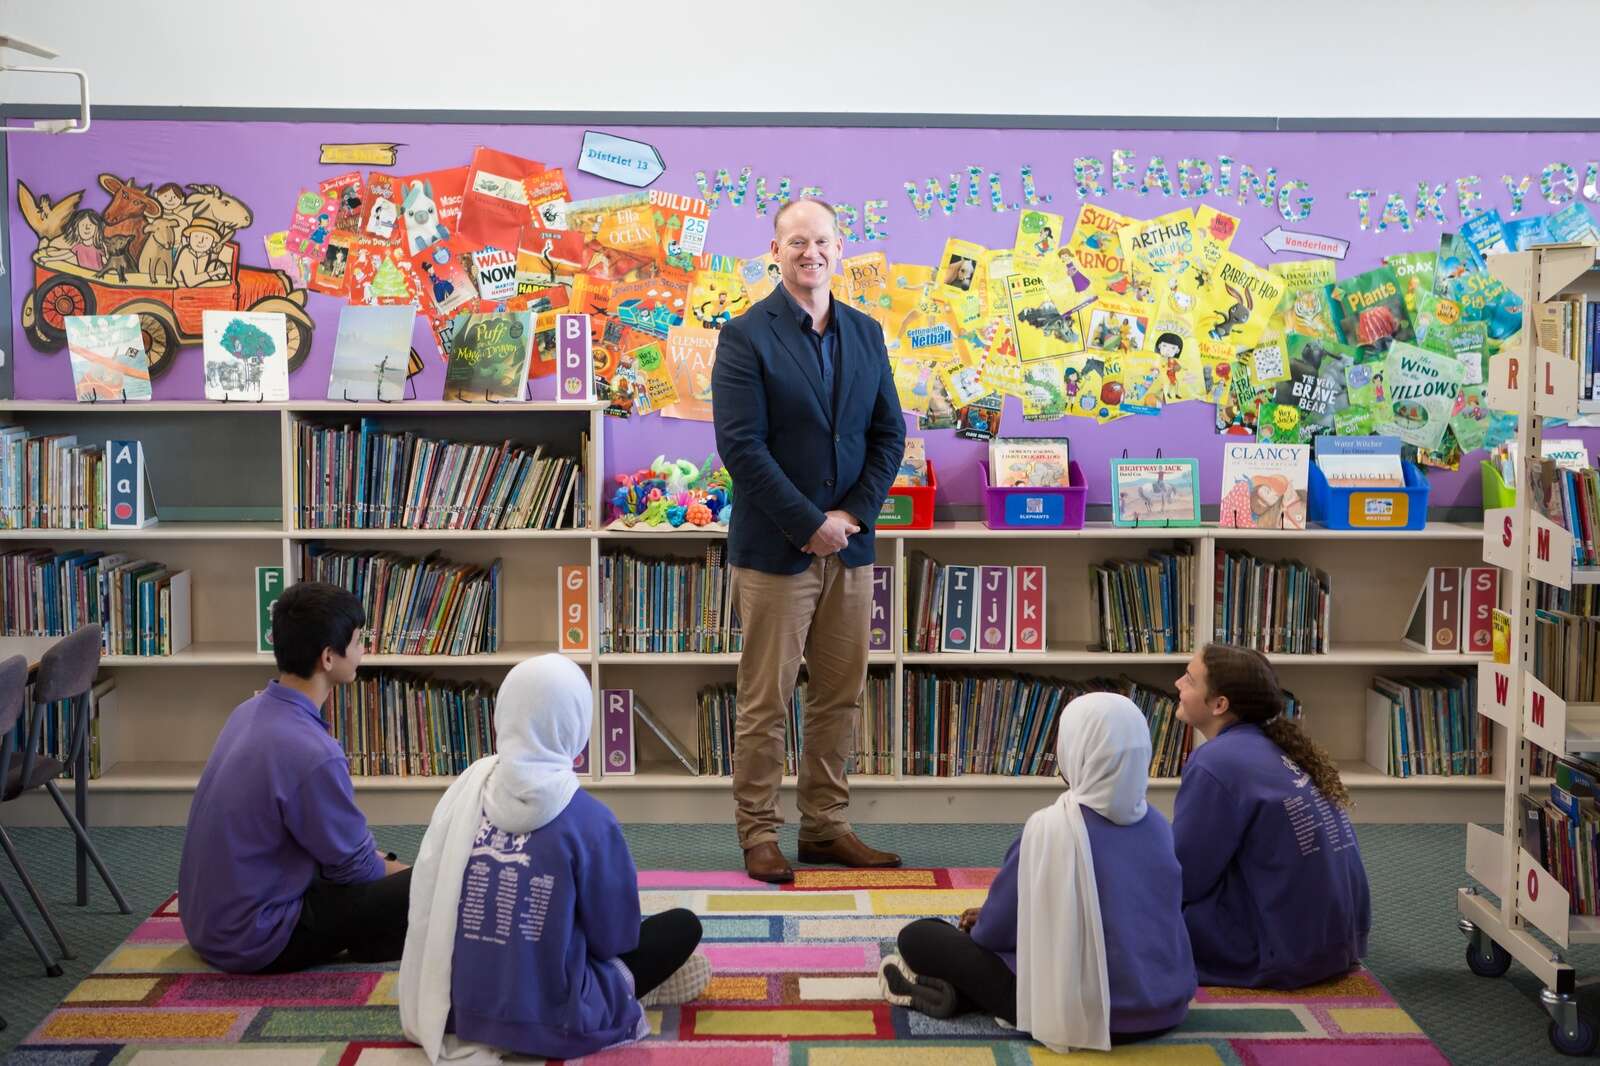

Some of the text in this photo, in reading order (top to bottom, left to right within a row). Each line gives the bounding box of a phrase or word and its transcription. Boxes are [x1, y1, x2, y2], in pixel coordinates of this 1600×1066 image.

[587, 147, 648, 171] District 13
[649, 190, 691, 212] BUILD
[695, 166, 889, 243] WHRE
[904, 164, 1053, 221] WILL
[1073, 149, 1315, 223] READING
[1347, 175, 1483, 233] TAKE
[616, 208, 641, 225] Ella
[685, 218, 706, 234] 25
[609, 226, 652, 245] OCEAN
[1131, 220, 1192, 251] ARTHUR
[1285, 236, 1339, 253] Wonderland
[476, 250, 517, 269] WALL
[1396, 262, 1434, 277] ORAX
[480, 264, 517, 285] NOW
[850, 262, 881, 281] BOY
[1258, 279, 1279, 301] HOP
[1348, 281, 1397, 312] Plants
[475, 322, 508, 345] Puff
[566, 318, 581, 339] B
[911, 329, 953, 349] Netball
[566, 347, 581, 369] b
[1400, 356, 1440, 378] WIND
[1302, 374, 1336, 390] THE VERY
[1507, 358, 1520, 390] R
[1545, 361, 1554, 395] L
[1291, 381, 1339, 405] BRAVE
[1298, 398, 1327, 415] BEAR
[1231, 446, 1301, 461] CLANCY
[1334, 439, 1354, 448] Water
[115, 445, 133, 465] A
[116, 478, 131, 494] a
[1502, 515, 1513, 548] S
[1536, 526, 1551, 562] M
[264, 571, 278, 592] F
[566, 570, 584, 590] G
[872, 571, 887, 591] H
[954, 571, 969, 591] I
[986, 571, 1003, 592] J
[1023, 571, 1038, 592] K
[1439, 571, 1454, 592] L
[1475, 573, 1492, 591] S
[568, 603, 582, 623] g
[872, 599, 885, 620] h
[956, 599, 963, 619] i
[987, 598, 998, 623] j
[1023, 599, 1036, 620] k
[1476, 604, 1489, 620] s
[1494, 671, 1509, 707] W
[609, 694, 625, 714] R
[1531, 690, 1545, 729] M
[611, 726, 623, 742] r
